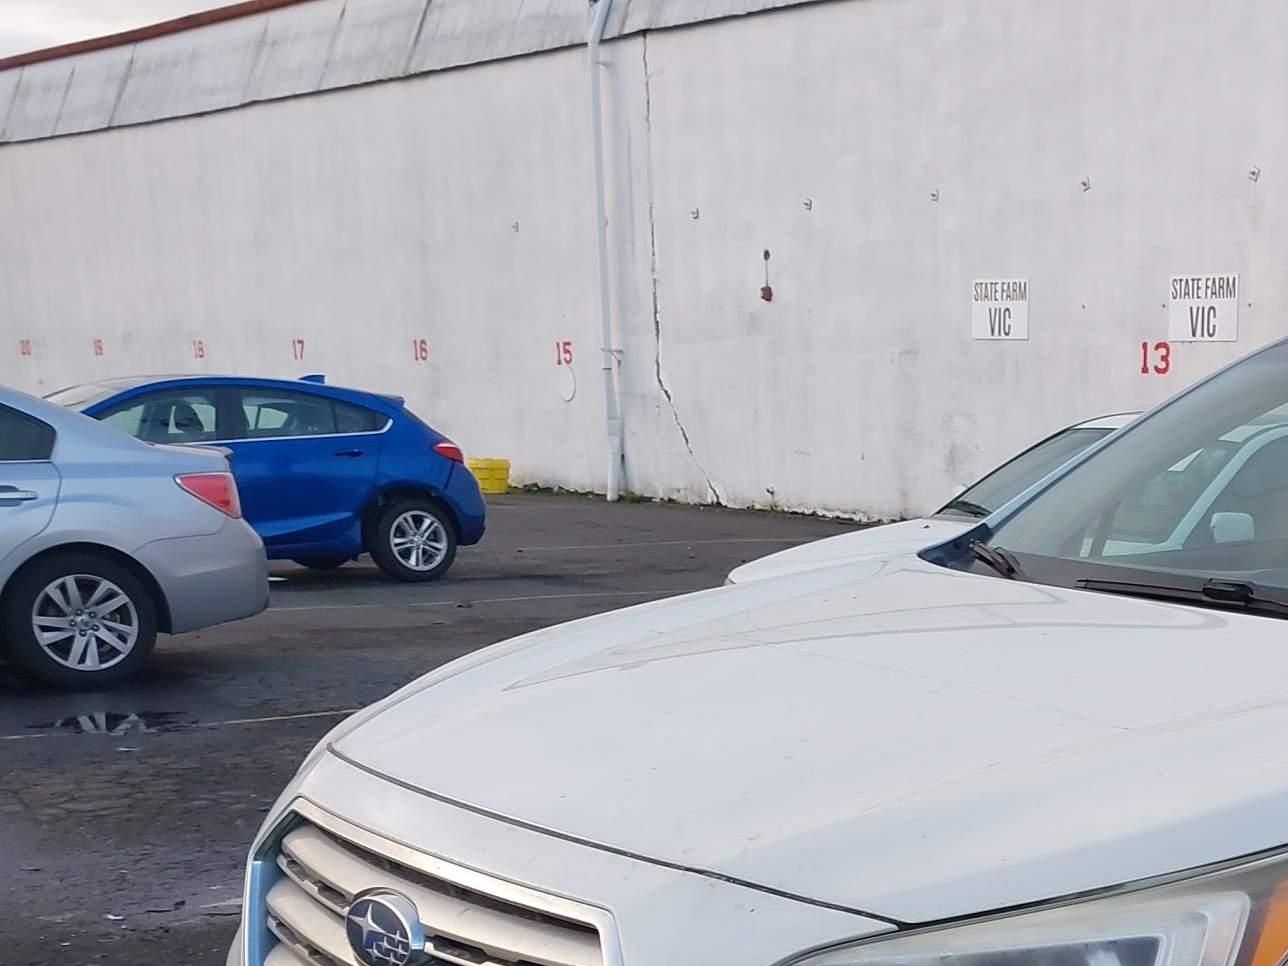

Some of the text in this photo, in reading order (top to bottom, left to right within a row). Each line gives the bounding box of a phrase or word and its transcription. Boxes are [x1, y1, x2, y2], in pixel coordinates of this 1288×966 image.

[973, 280, 1027, 302] STATE FARM
[1171, 276, 1236, 300] STATE FARM
[988, 307, 1012, 337] VIC
[1189, 306, 1217, 338] VIC
[292, 339, 304, 360] 17
[413, 339, 428, 361] 16
[556, 341, 573, 366] 15
[1141, 342, 1169, 374] 13
